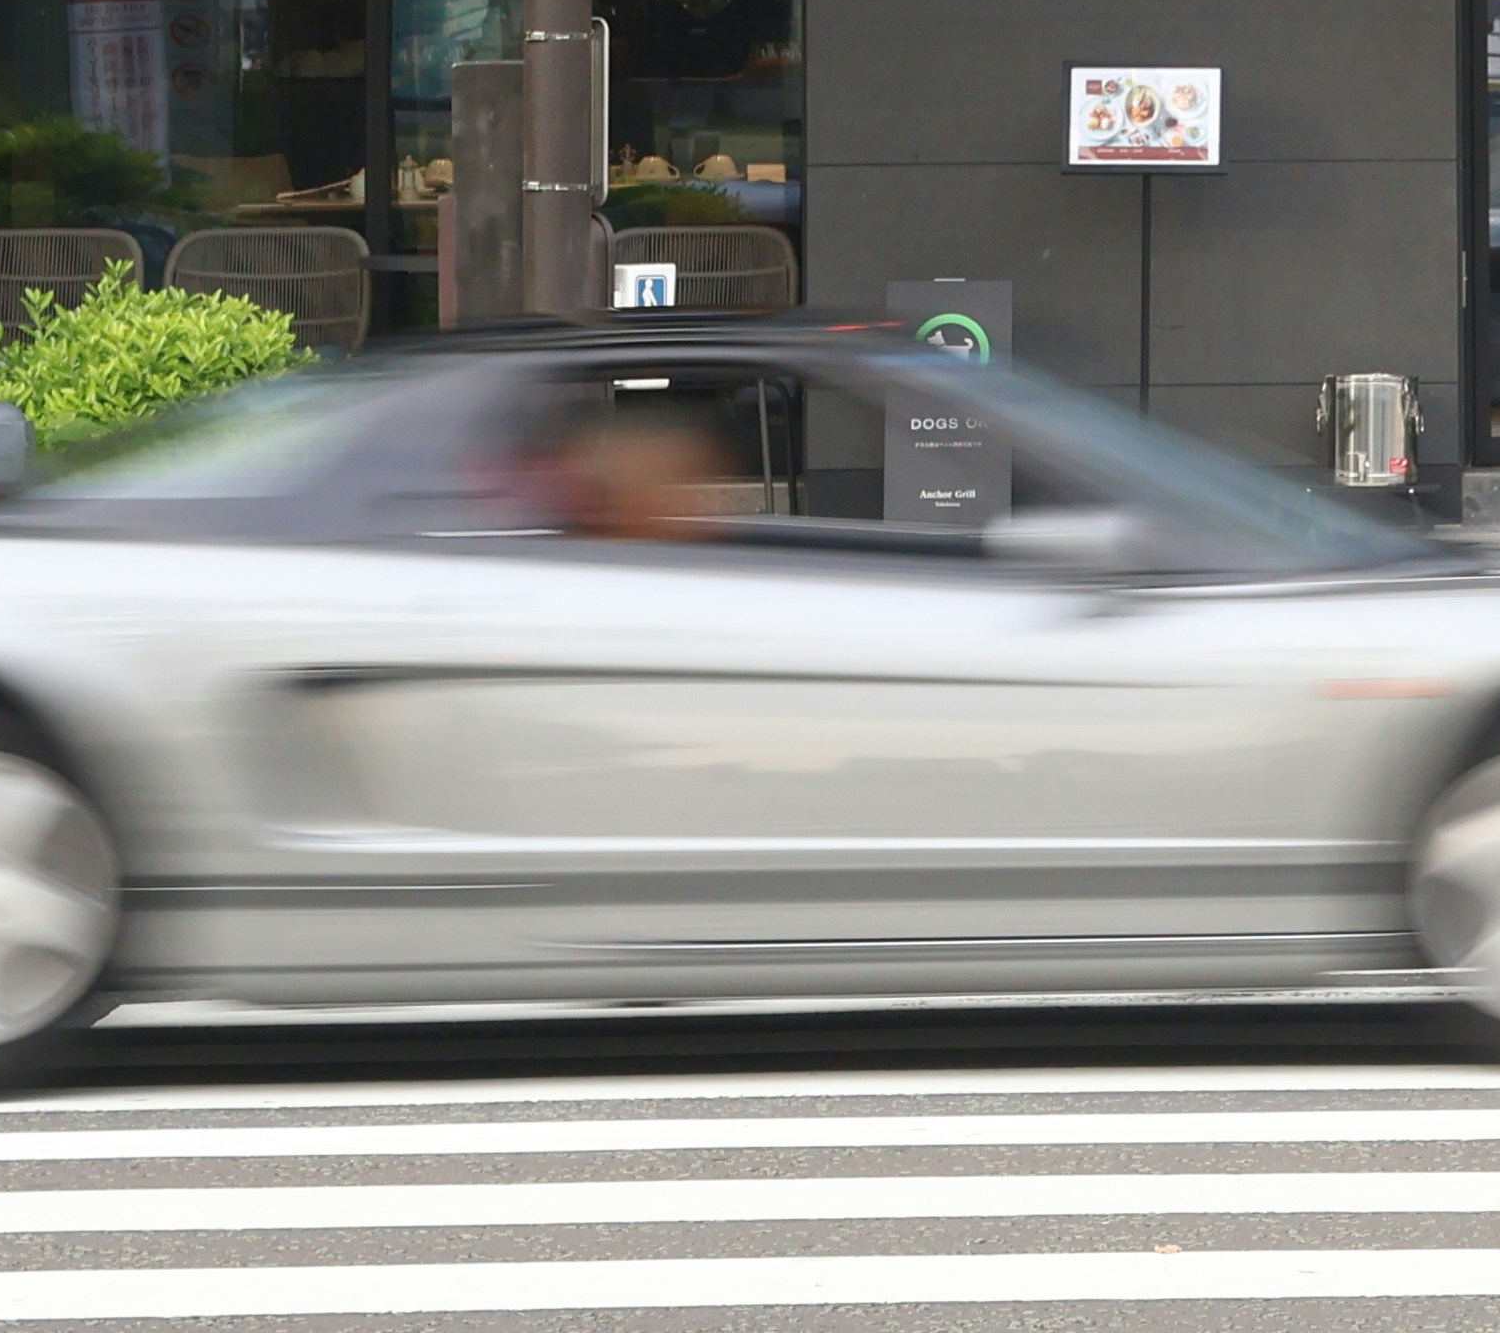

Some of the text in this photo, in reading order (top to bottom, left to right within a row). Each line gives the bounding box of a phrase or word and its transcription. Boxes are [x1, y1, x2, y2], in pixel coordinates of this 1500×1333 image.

[911, 418, 958, 430] DOGS
[920, 489, 975, 499] Anchor Grill
